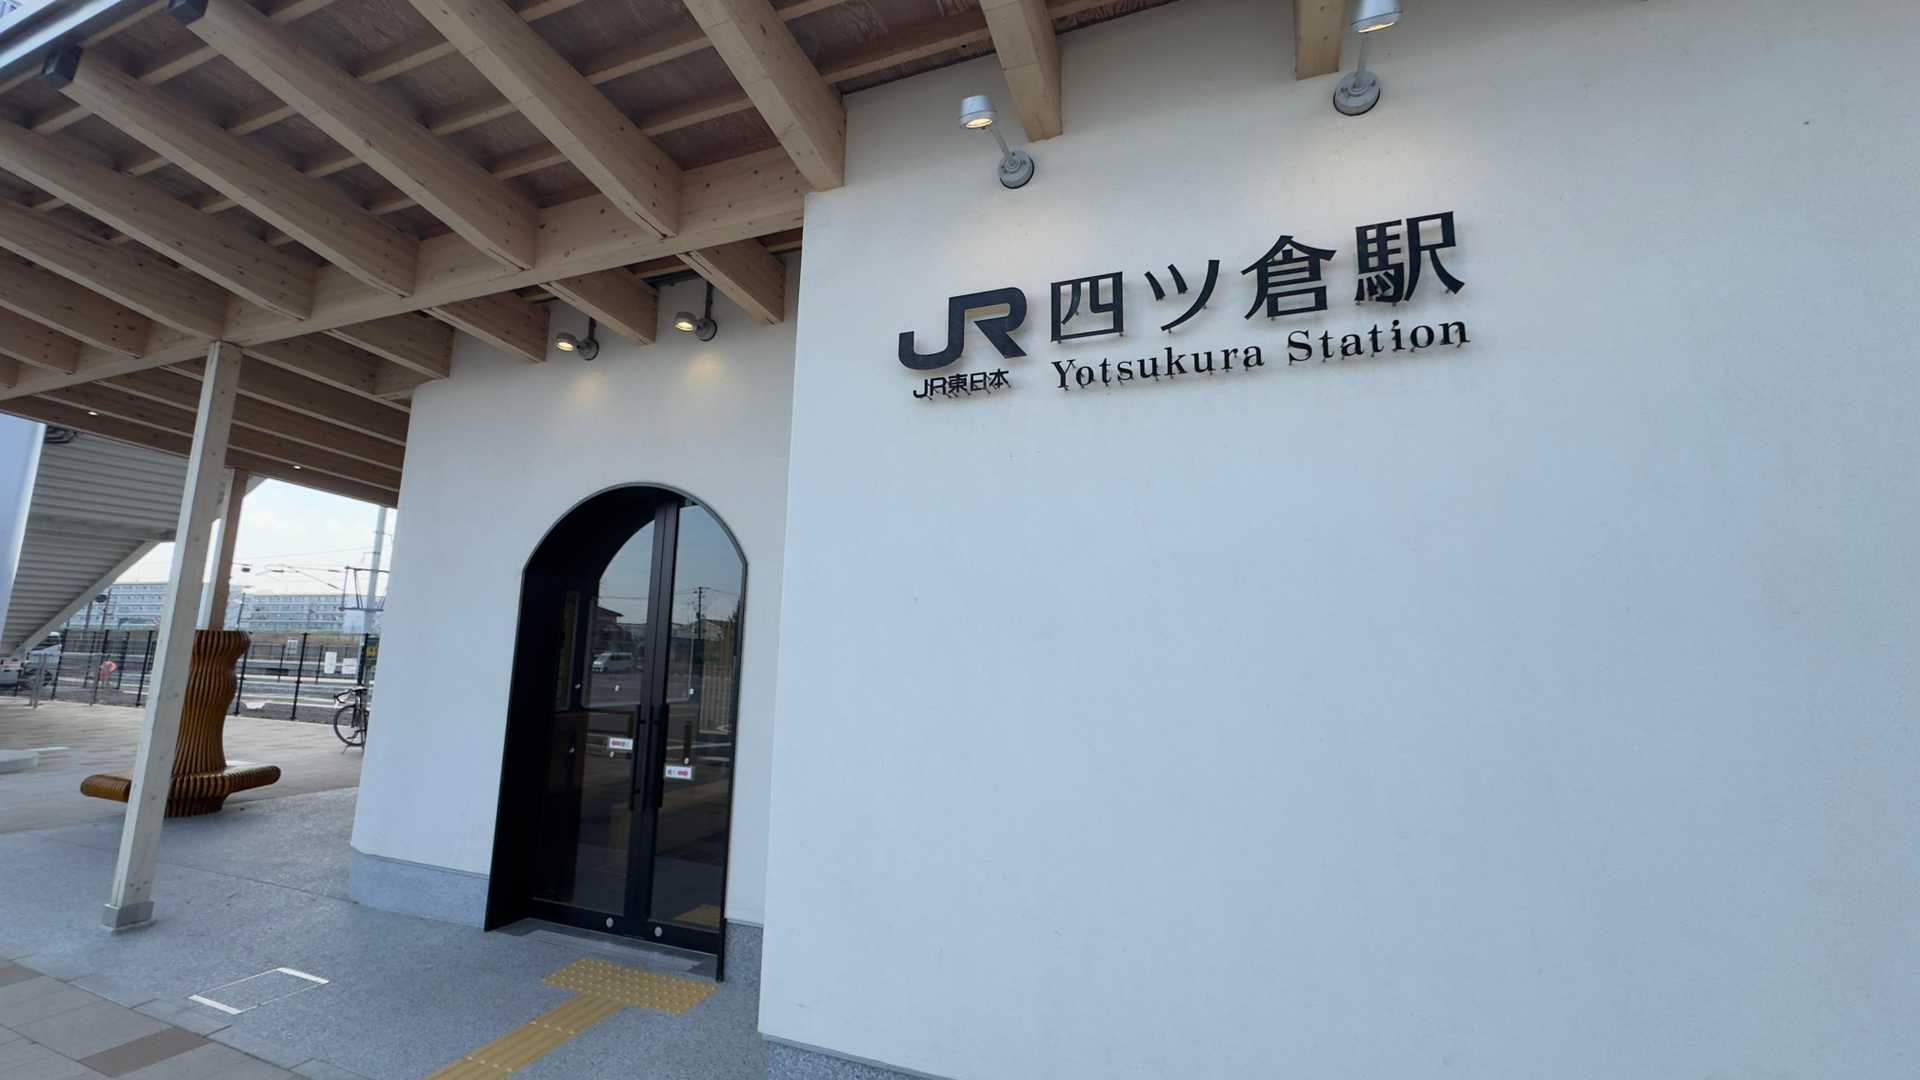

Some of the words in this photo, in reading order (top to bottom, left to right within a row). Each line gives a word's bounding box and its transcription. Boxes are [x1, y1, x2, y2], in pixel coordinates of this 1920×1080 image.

[1050, 211, 1464, 342] 四ツ倉駅
[898, 287, 1027, 369] JR
[1051, 347, 1264, 389] Yotsukura
[1287, 319, 1470, 364] Station
[913, 369, 1010, 398] JR東日本
